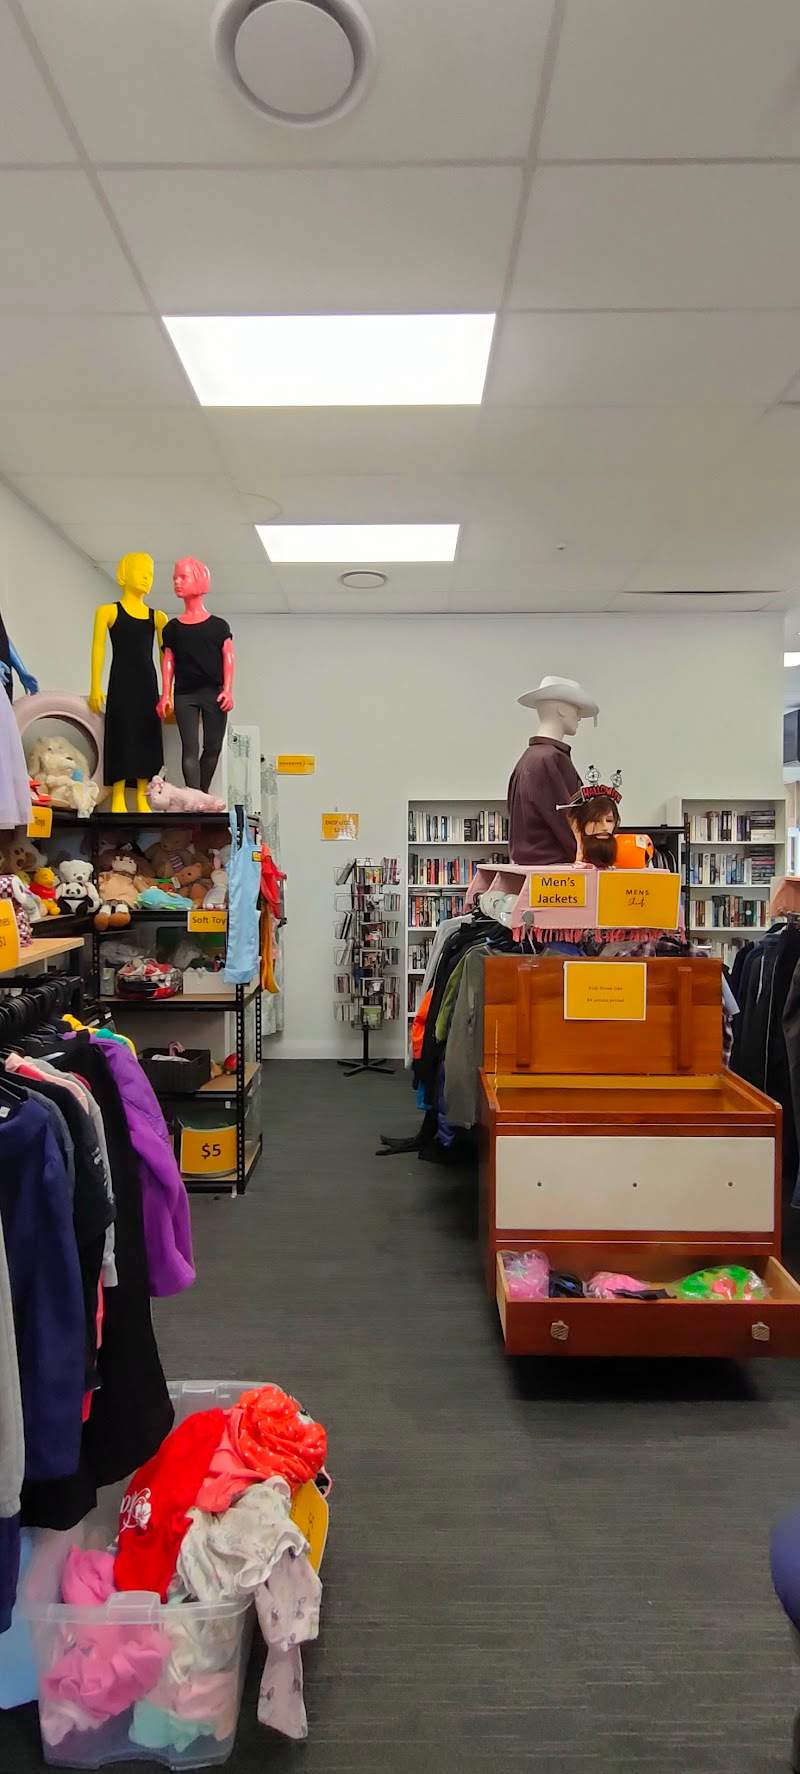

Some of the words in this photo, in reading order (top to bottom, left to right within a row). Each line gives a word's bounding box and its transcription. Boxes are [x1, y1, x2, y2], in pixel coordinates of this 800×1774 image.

[541, 877, 575, 887] Men's
[538, 894, 578, 904] Jackets
[192, 916, 208, 924] Soft
[201, 1143, 221, 1159] $5
